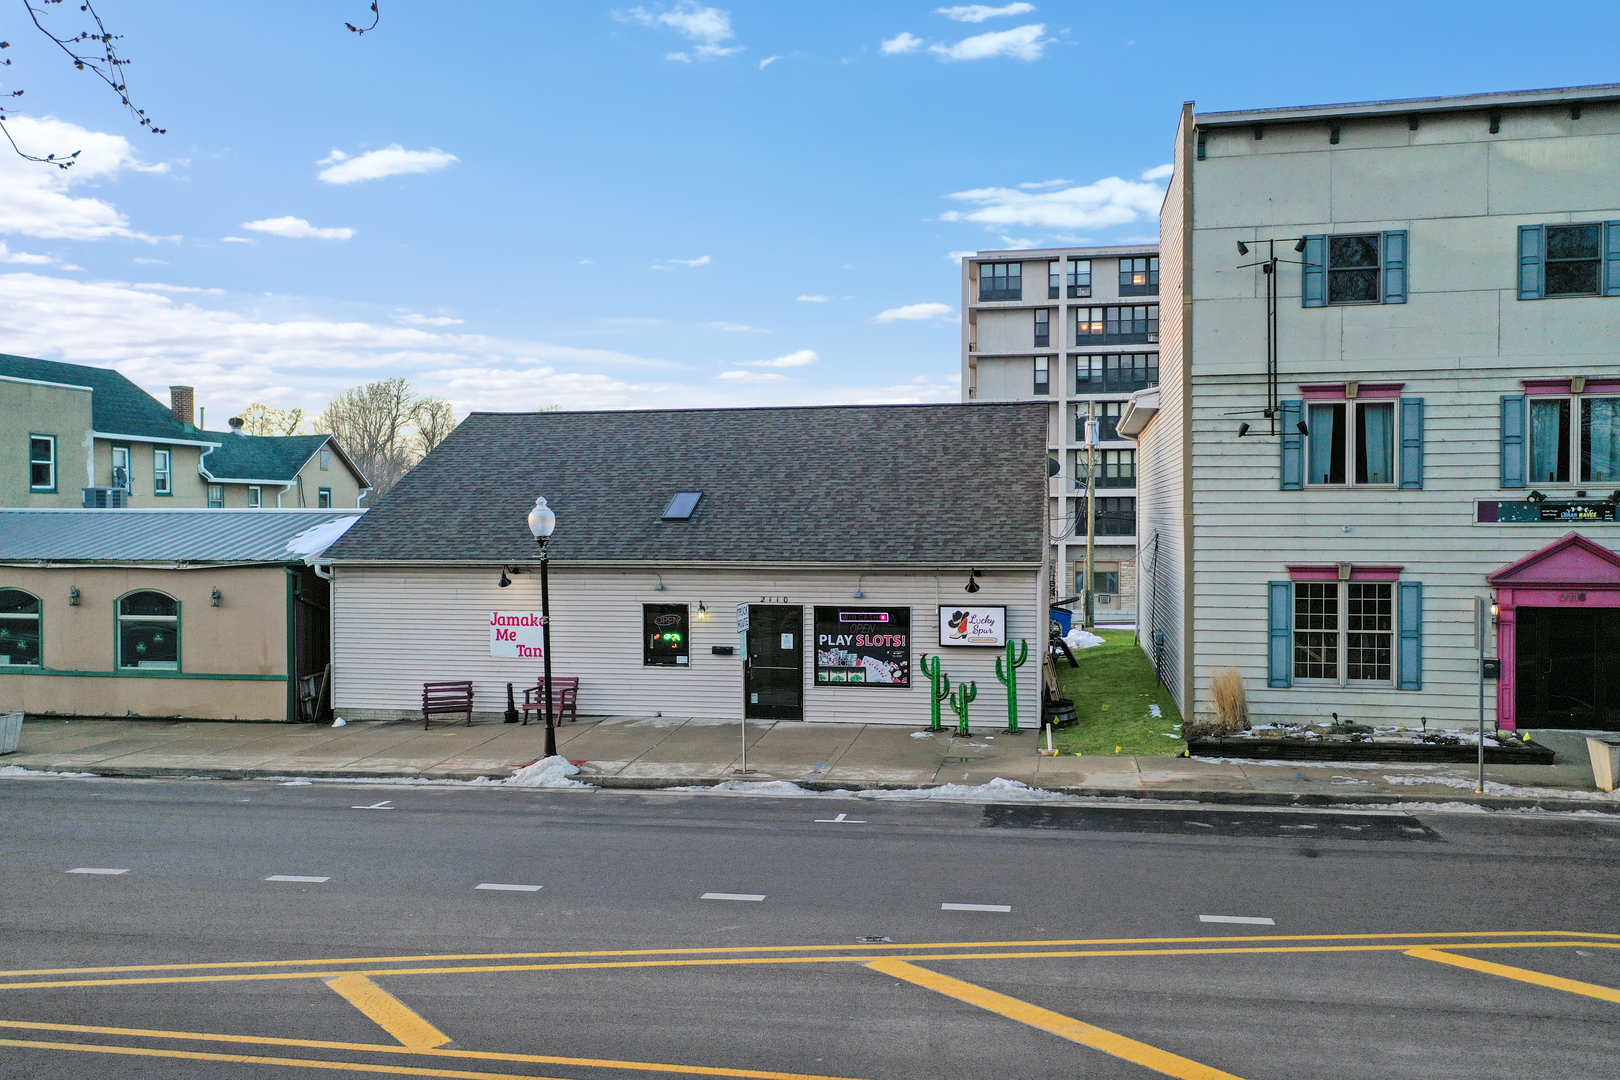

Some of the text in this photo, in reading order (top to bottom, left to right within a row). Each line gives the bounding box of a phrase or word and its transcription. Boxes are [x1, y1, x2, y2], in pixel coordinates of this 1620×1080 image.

[655, 616, 680, 624] OPEN
[969, 614, 996, 626] Lucky
[495, 628, 517, 642] Me
[850, 624, 876, 634] OPEN
[972, 624, 994, 636] Spur
[819, 634, 906, 646] PLAY SLOTS!
[516, 644, 543, 658] Tan
